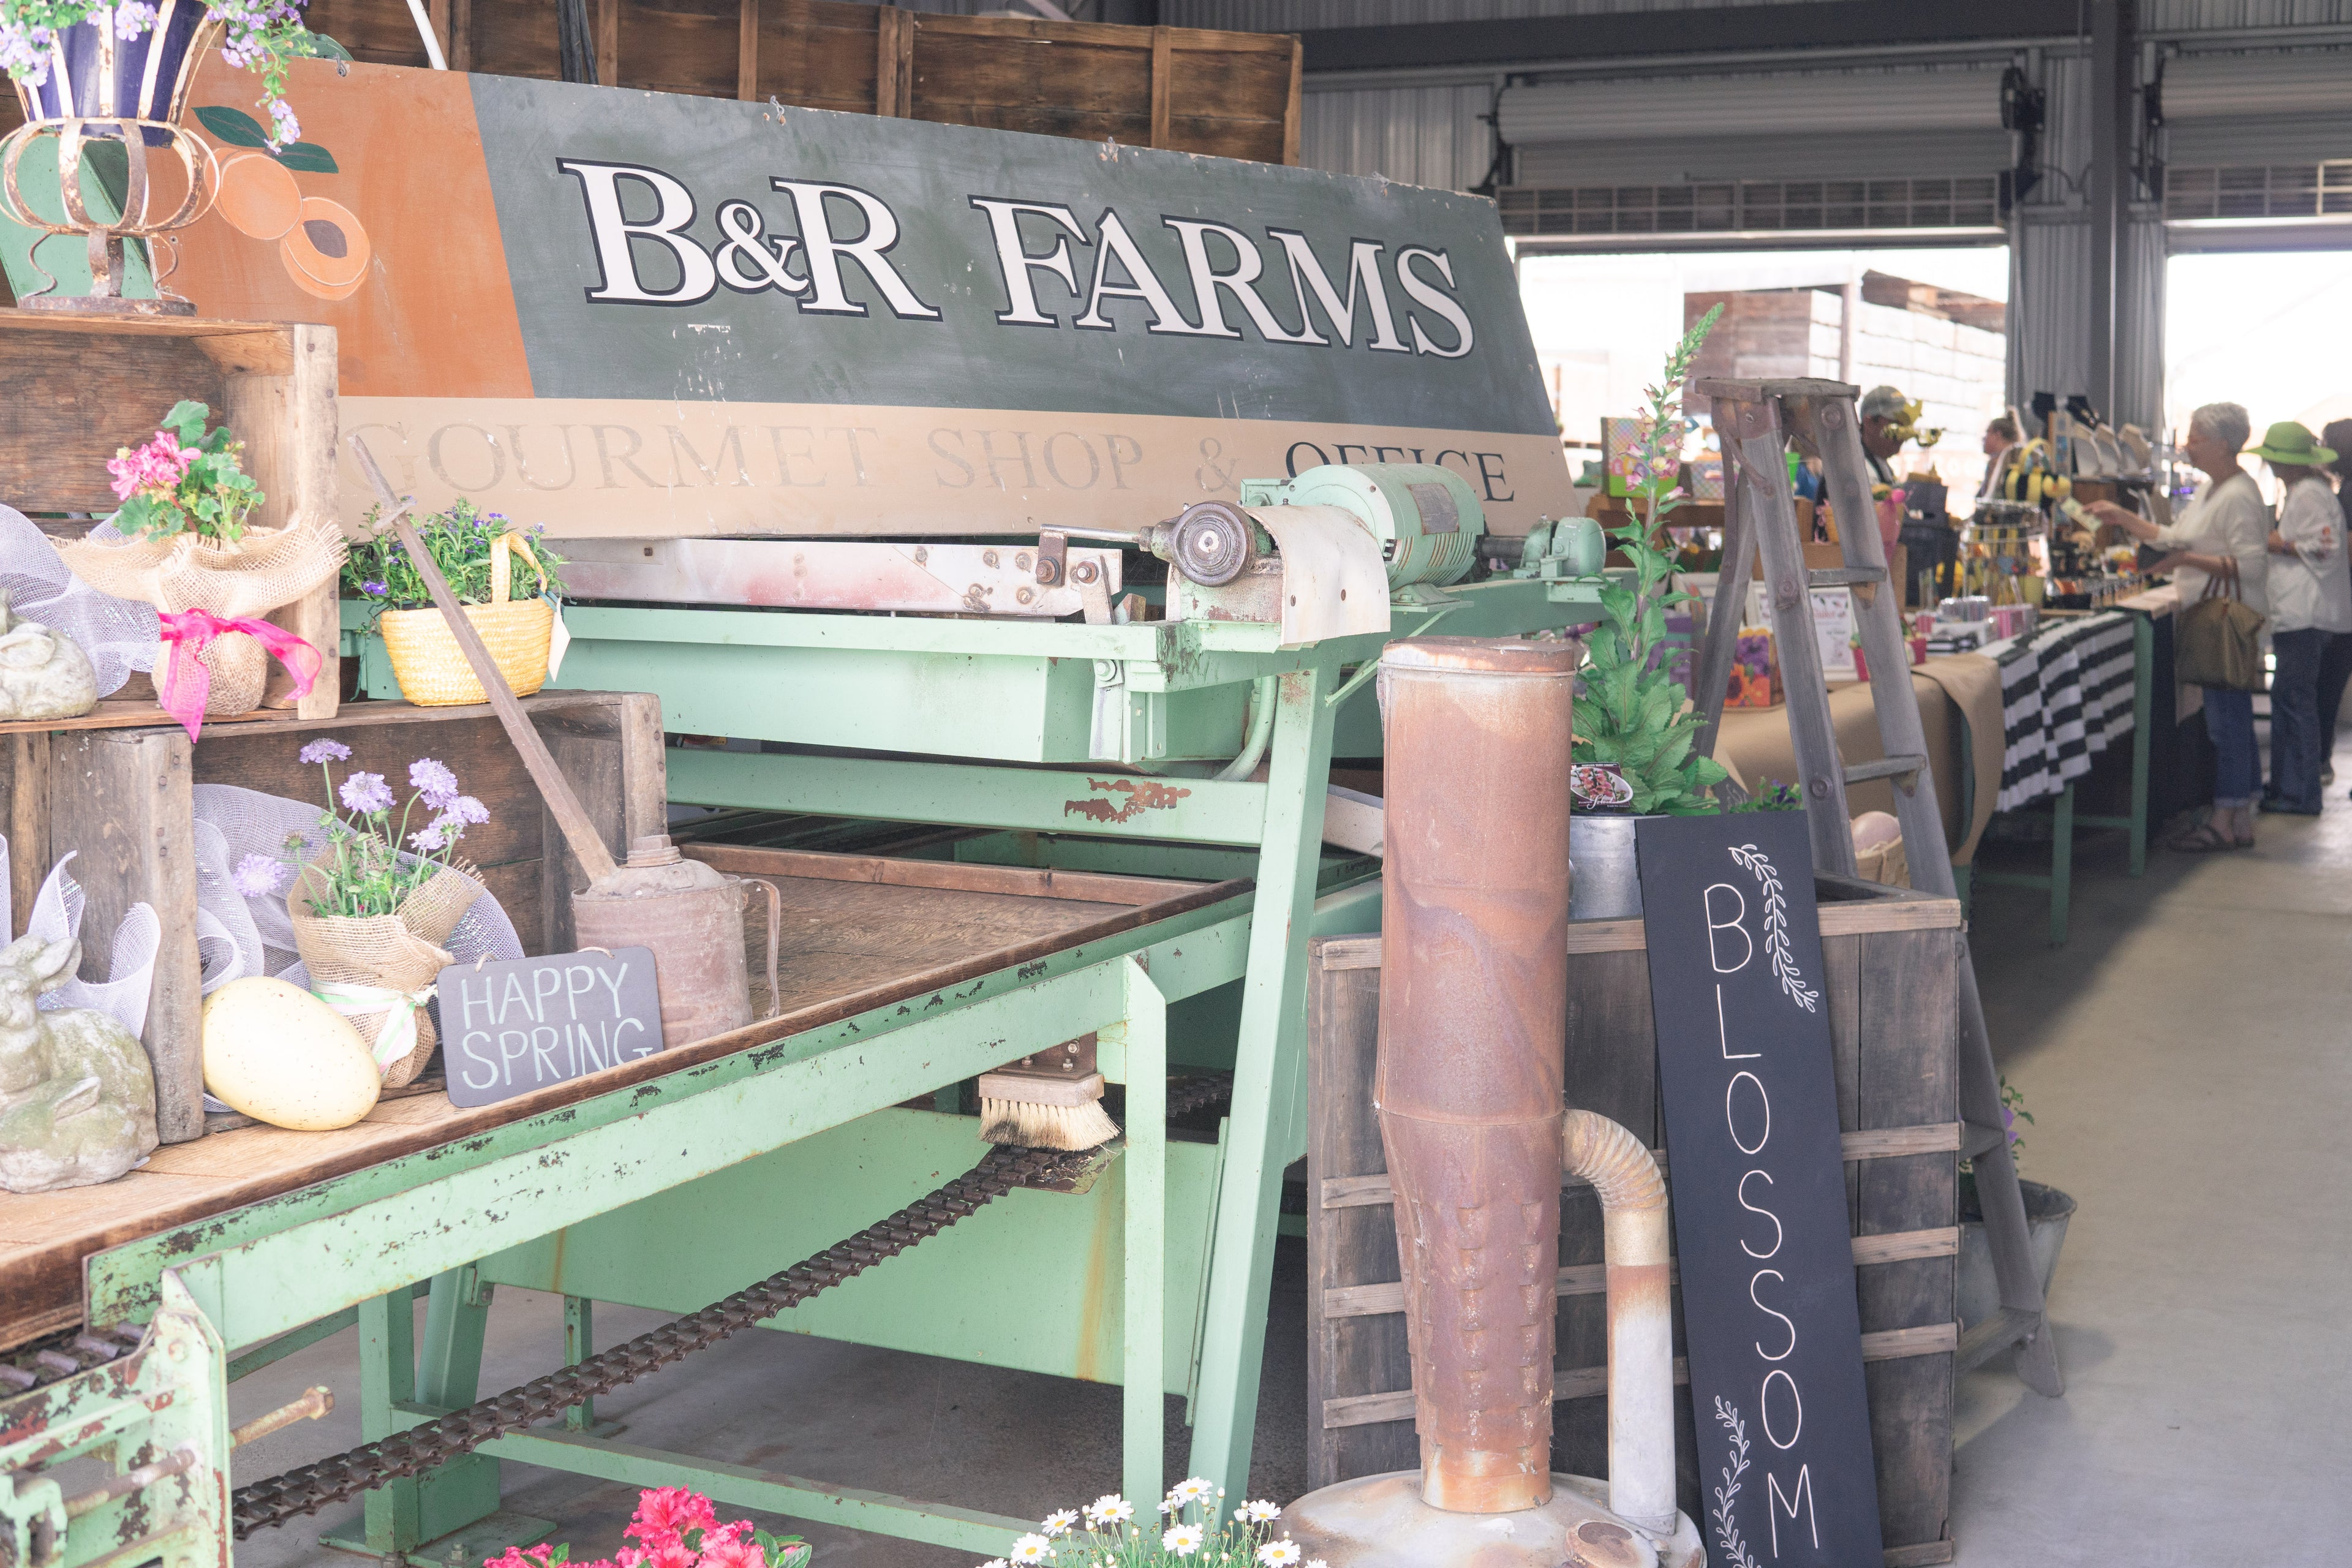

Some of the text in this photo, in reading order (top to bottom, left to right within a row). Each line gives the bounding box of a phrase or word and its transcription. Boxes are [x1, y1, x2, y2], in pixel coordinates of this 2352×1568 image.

[556, 157, 1474, 359] B&R FARMS
[339, 423, 881, 492] GOURMET
[927, 428, 1143, 491] SHOP
[1195, 437, 1241, 492] &
[461, 963, 628, 1030] HAPPY
[462, 1017, 654, 1089] SPRING
[1705, 884, 1819, 1558] BLOSSOM
